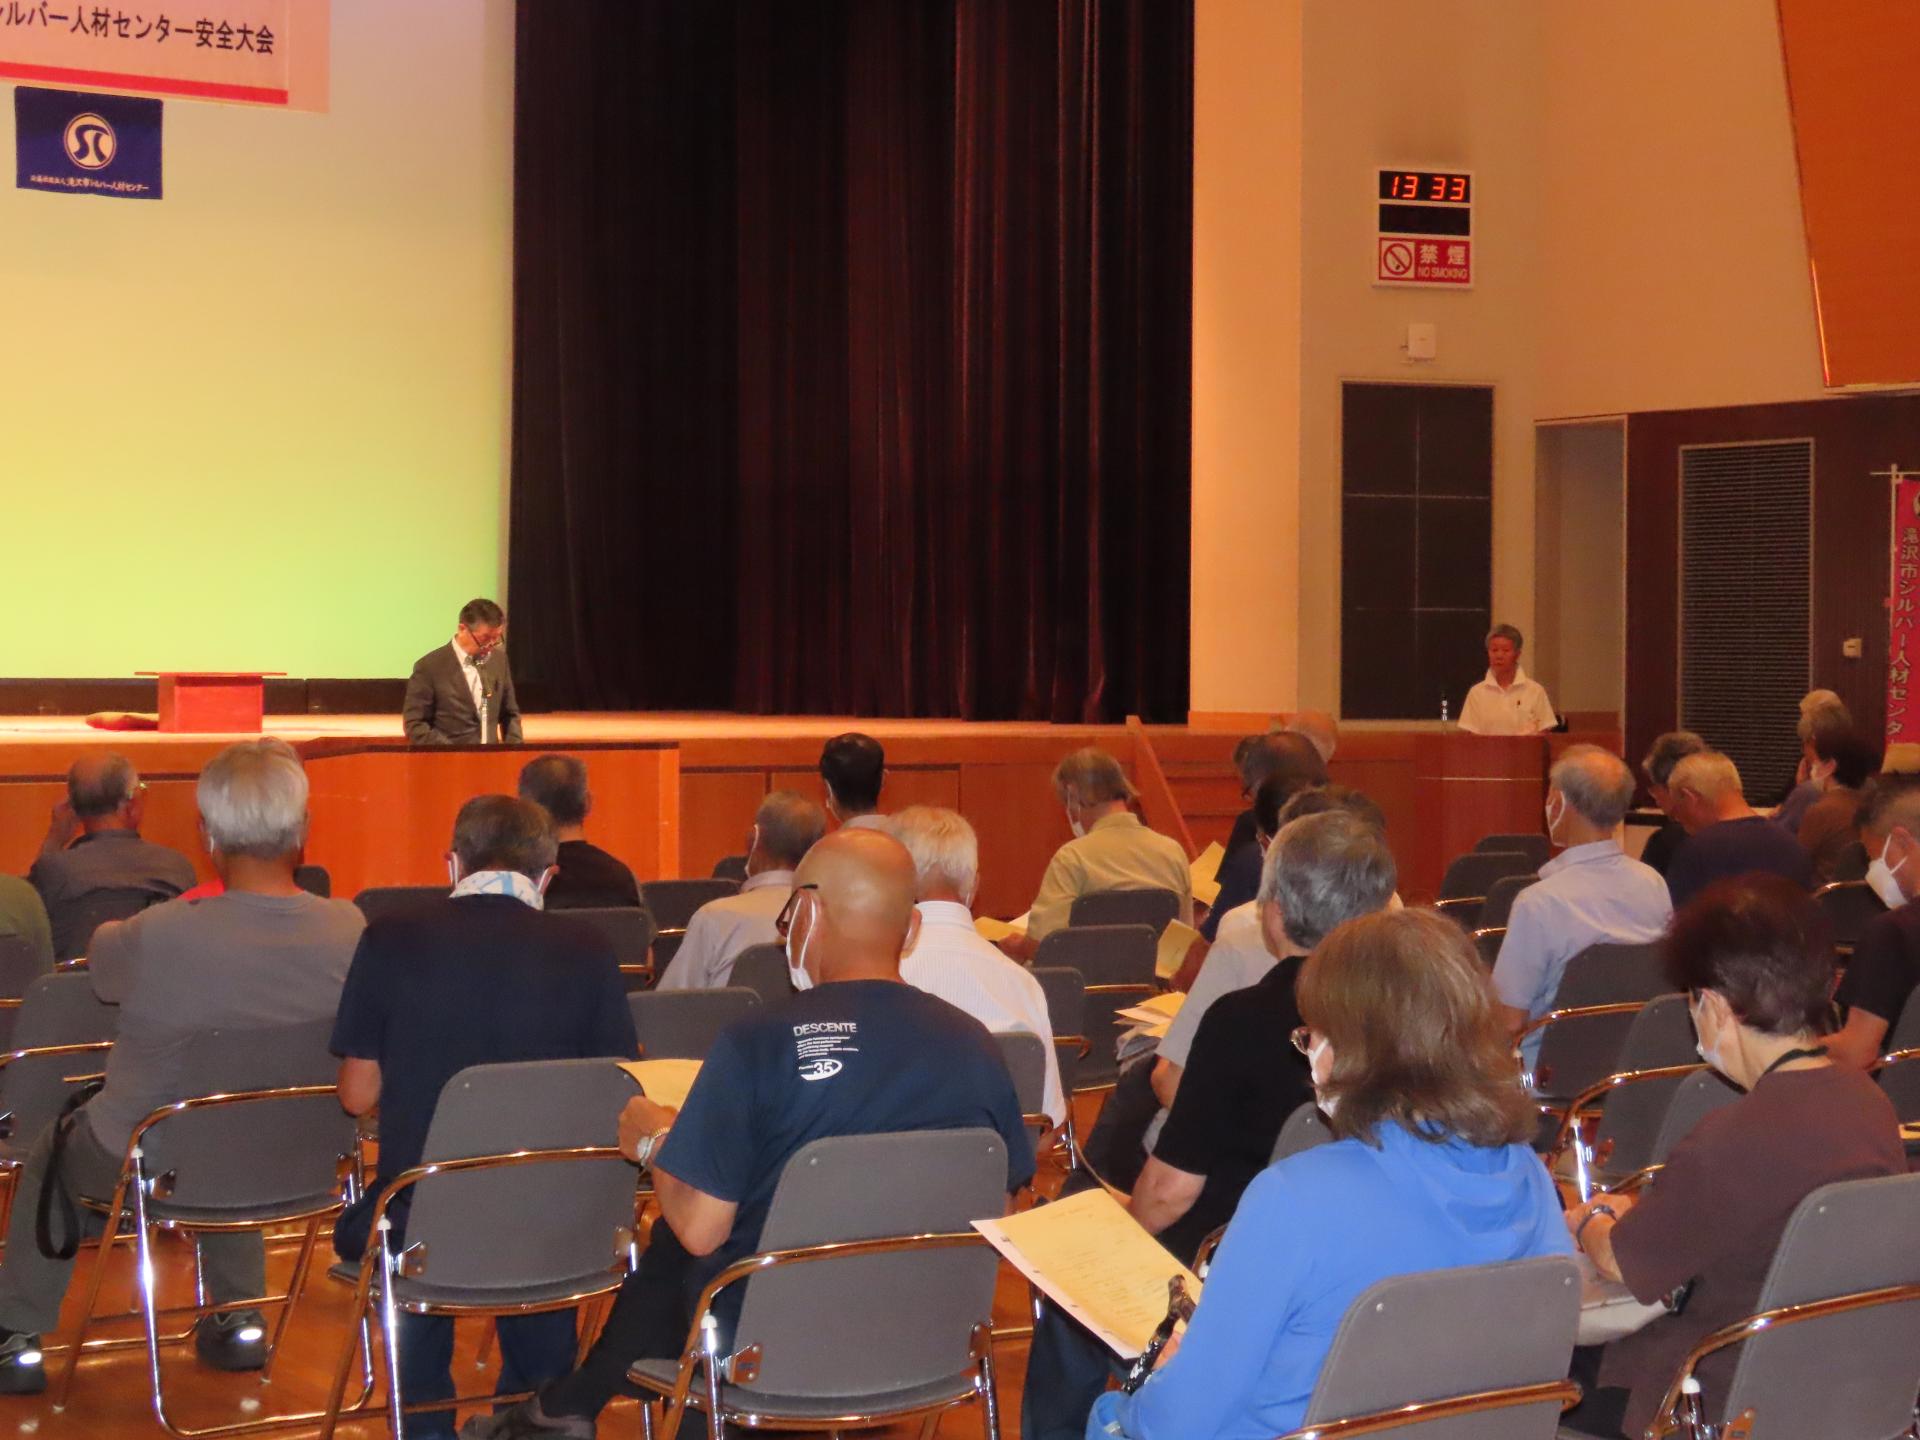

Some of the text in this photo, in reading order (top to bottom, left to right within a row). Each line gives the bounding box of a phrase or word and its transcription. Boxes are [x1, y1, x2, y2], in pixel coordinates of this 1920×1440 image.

[1392, 175, 1466, 200] 13 33
[793, 1022, 858, 1036] DESCENTE
[813, 1062, 833, 1075] 35
